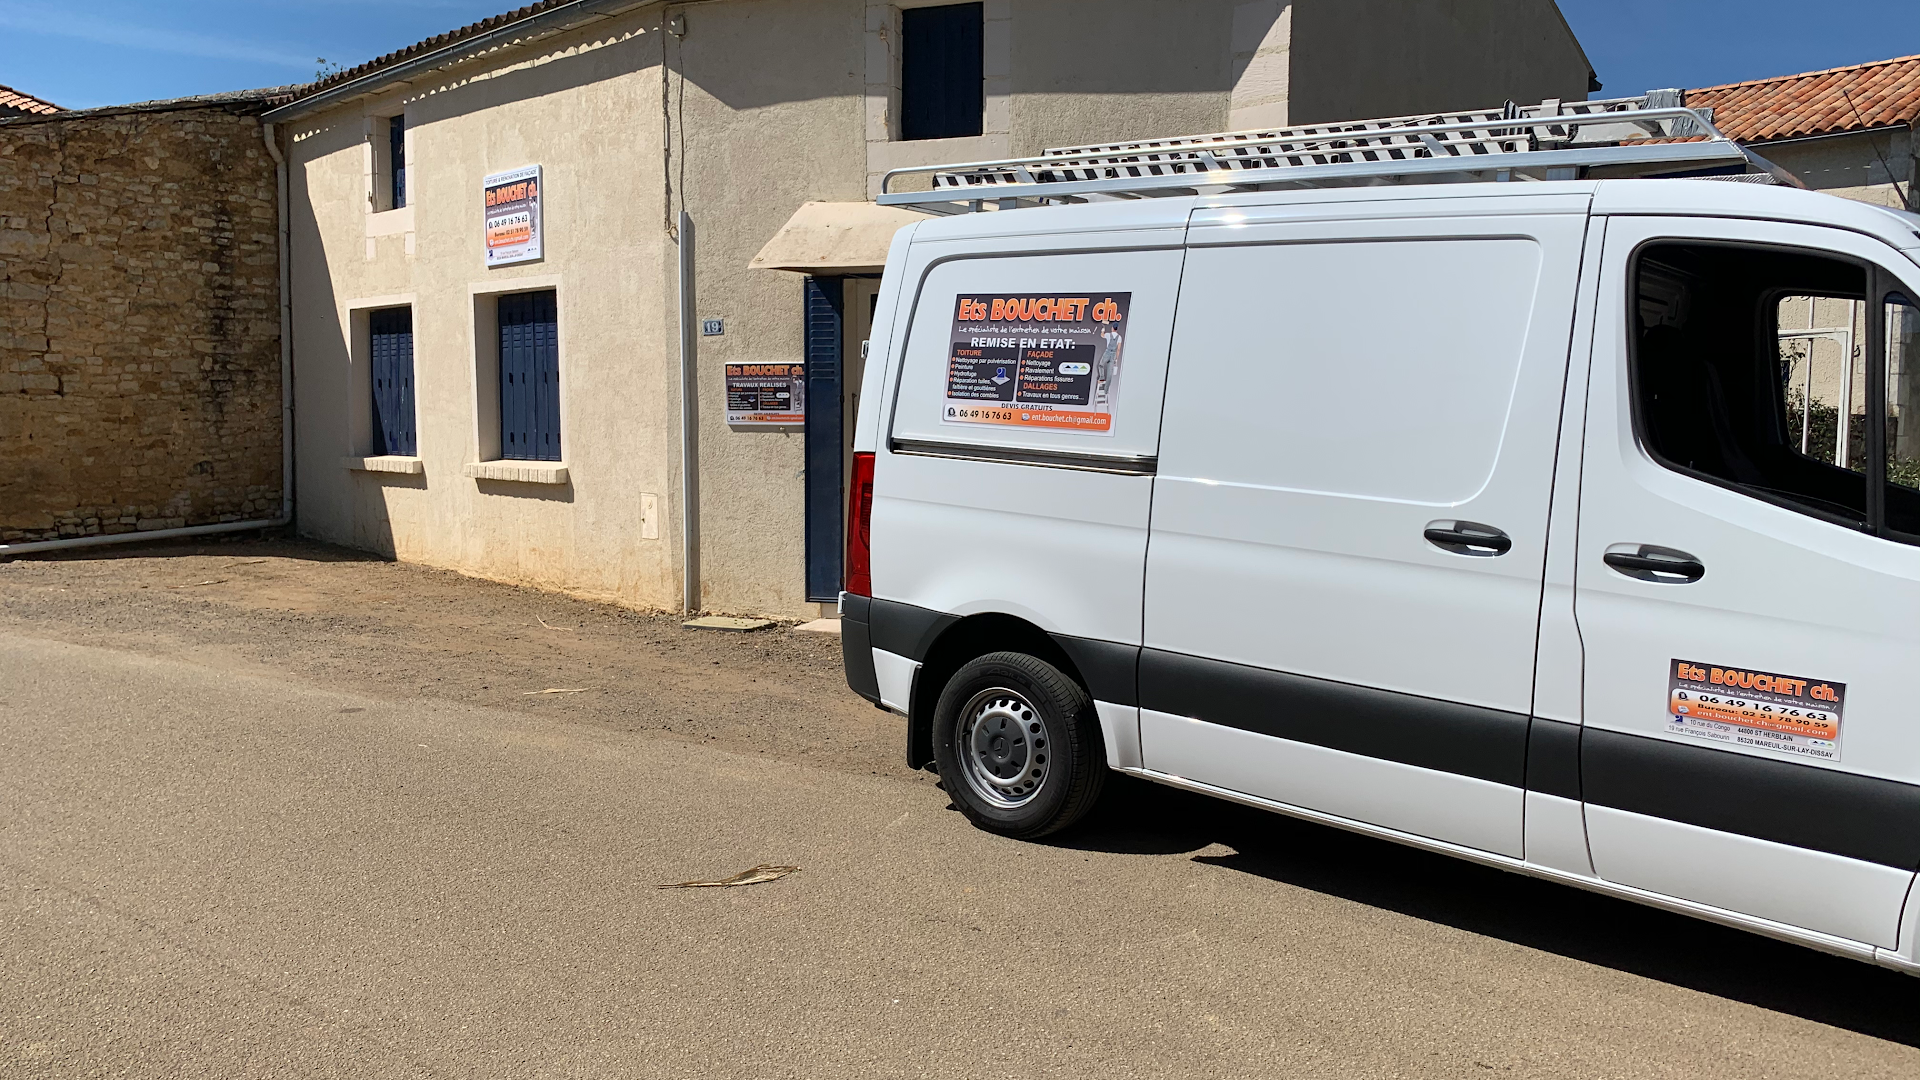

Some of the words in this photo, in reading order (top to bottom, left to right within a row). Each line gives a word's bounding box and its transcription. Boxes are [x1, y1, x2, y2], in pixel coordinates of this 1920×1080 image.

[486, 190, 496, 206] Ets
[496, 182, 527, 204] BOUCHET
[515, 216, 520, 224] 76
[958, 298, 987, 320] Ets
[990, 298, 1090, 321] BOUCHET
[1092, 298, 1122, 321] ch.
[706, 322, 718, 332] 19
[968, 324, 999, 333] spécialiste
[1009, 324, 1040, 334] l'entretien
[1041, 326, 1049, 334] de
[1050, 325, 1067, 334] votre
[971, 337, 1016, 348] REMISE
[1020, 338, 1036, 348] EN
[1040, 339, 1075, 349] ETAT:
[1027, 351, 1054, 359] FAÇADE
[743, 365, 789, 376] BOUCHET
[960, 409, 968, 417] 06
[970, 410, 979, 418] 49
[982, 411, 990, 419] 16
[1003, 412, 1012, 420] 63
[1678, 663, 1706, 681] Ets
[1710, 668, 1807, 696] BOUCHET
[1810, 683, 1839, 702] ch.
[1700, 695, 1720, 704] 06
[1754, 703, 1772, 712] 16
[1779, 708, 1800, 716] 76
[1806, 712, 1827, 720] 63
[1784, 698, 1803, 706] votre
[1698, 704, 1738, 714] Bureau:
[1714, 724, 1730, 732] Congo
[1763, 732, 1793, 741] HERBLAIN
[1684, 728, 1706, 736] François
[1755, 740, 1833, 758] MAREUIL-SUR-LAY-DISSAY
